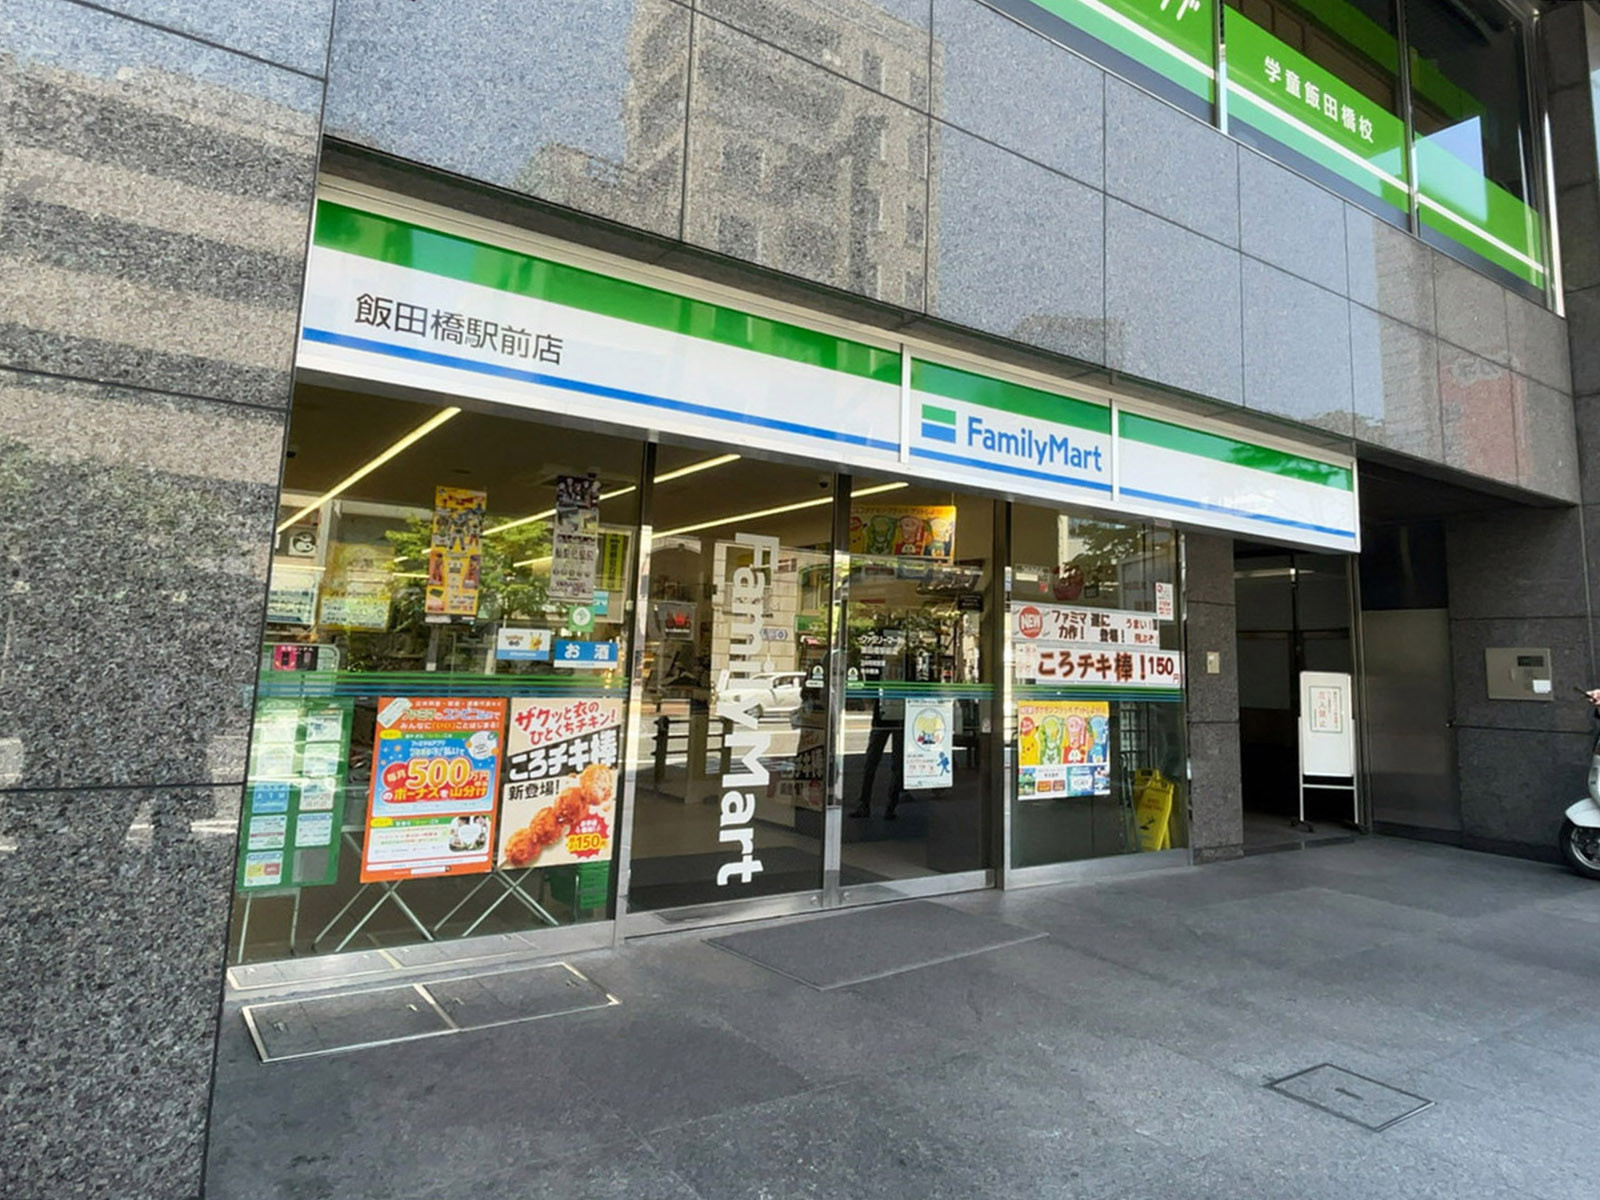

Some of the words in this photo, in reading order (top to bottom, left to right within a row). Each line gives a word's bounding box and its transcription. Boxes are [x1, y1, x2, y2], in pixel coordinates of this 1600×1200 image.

[1264, 56, 1374, 143] 学童飯田橋校
[355, 293, 563, 365] 飯田橋駅前店
[967, 416, 1103, 473] FamilyMart
[1051, 610, 1087, 625] ファミマ
[564, 643, 610, 660] お酒
[1038, 650, 1147, 682] ころチキ棒！
[515, 700, 600, 732] ザクッと衣の
[530, 709, 616, 745] ひとくちチキン！
[716, 532, 779, 887] FamilyMart
[509, 730, 617, 781] ころチキ棒
[508, 779, 560, 801] 新登場！
